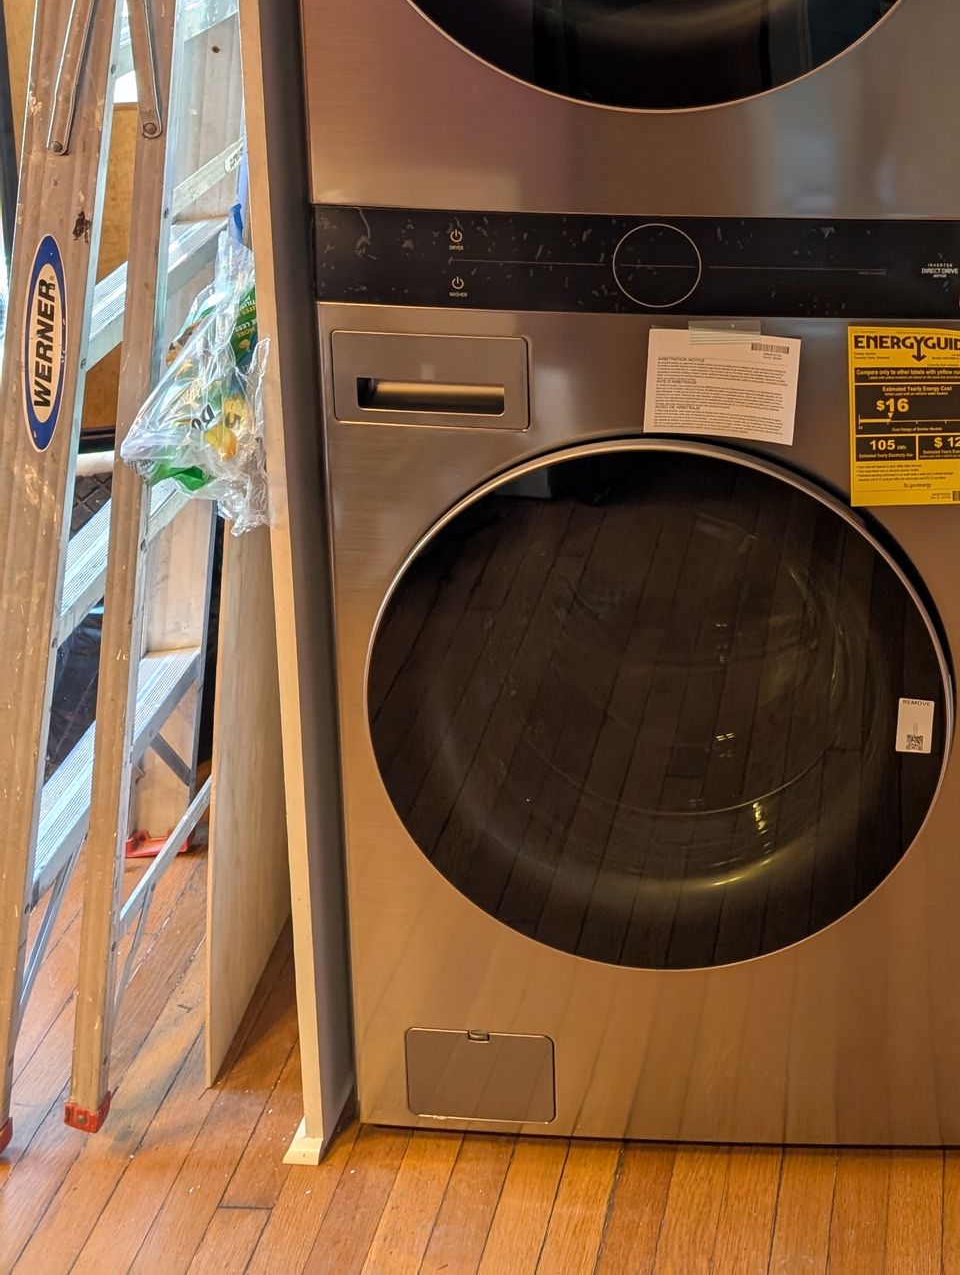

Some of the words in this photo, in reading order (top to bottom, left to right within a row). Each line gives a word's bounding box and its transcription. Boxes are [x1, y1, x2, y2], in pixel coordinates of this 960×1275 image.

[34, 278, 56, 408] WERNER
[876, 398, 909, 413] $16
[869, 439, 896, 451] 105
[934, 436, 943, 448] $
[902, 699, 931, 707] REMOVE
